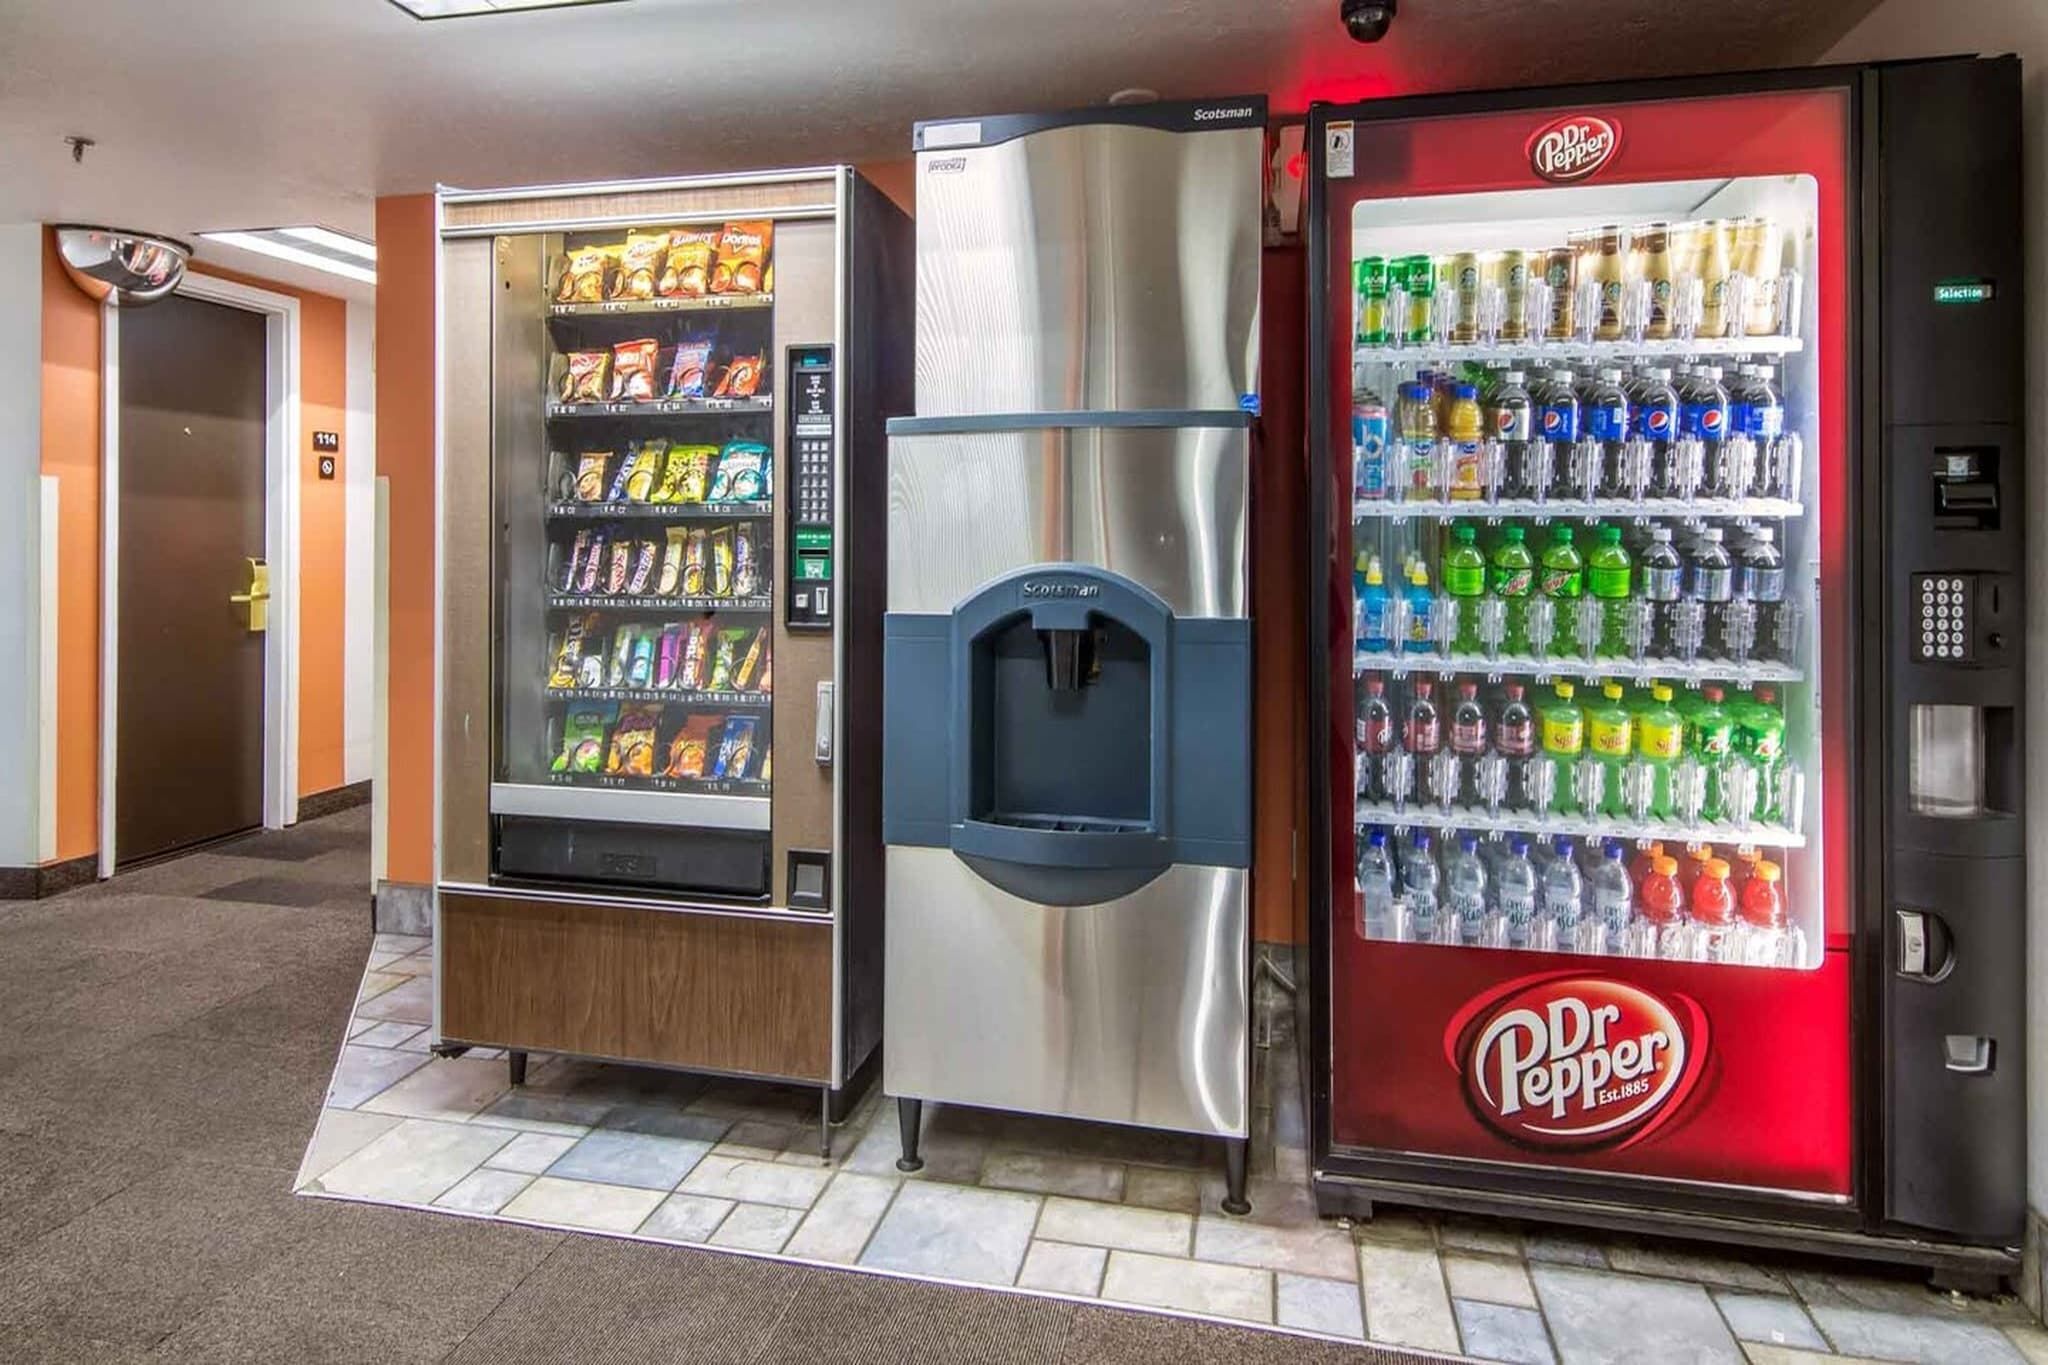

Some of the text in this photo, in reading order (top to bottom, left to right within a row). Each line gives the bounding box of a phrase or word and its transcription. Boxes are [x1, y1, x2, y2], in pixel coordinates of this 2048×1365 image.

[1194, 107, 1253, 121] Scotsman
[1563, 124, 1590, 149] Dr
[1538, 131, 1608, 173] Pepper
[316, 432, 337, 445] 114
[1023, 581, 1099, 597] Scotsman
[1547, 997, 1621, 1060] Dr
[1476, 1009, 1669, 1119] Pepper
[1599, 1078, 1650, 1105] Est.1885
